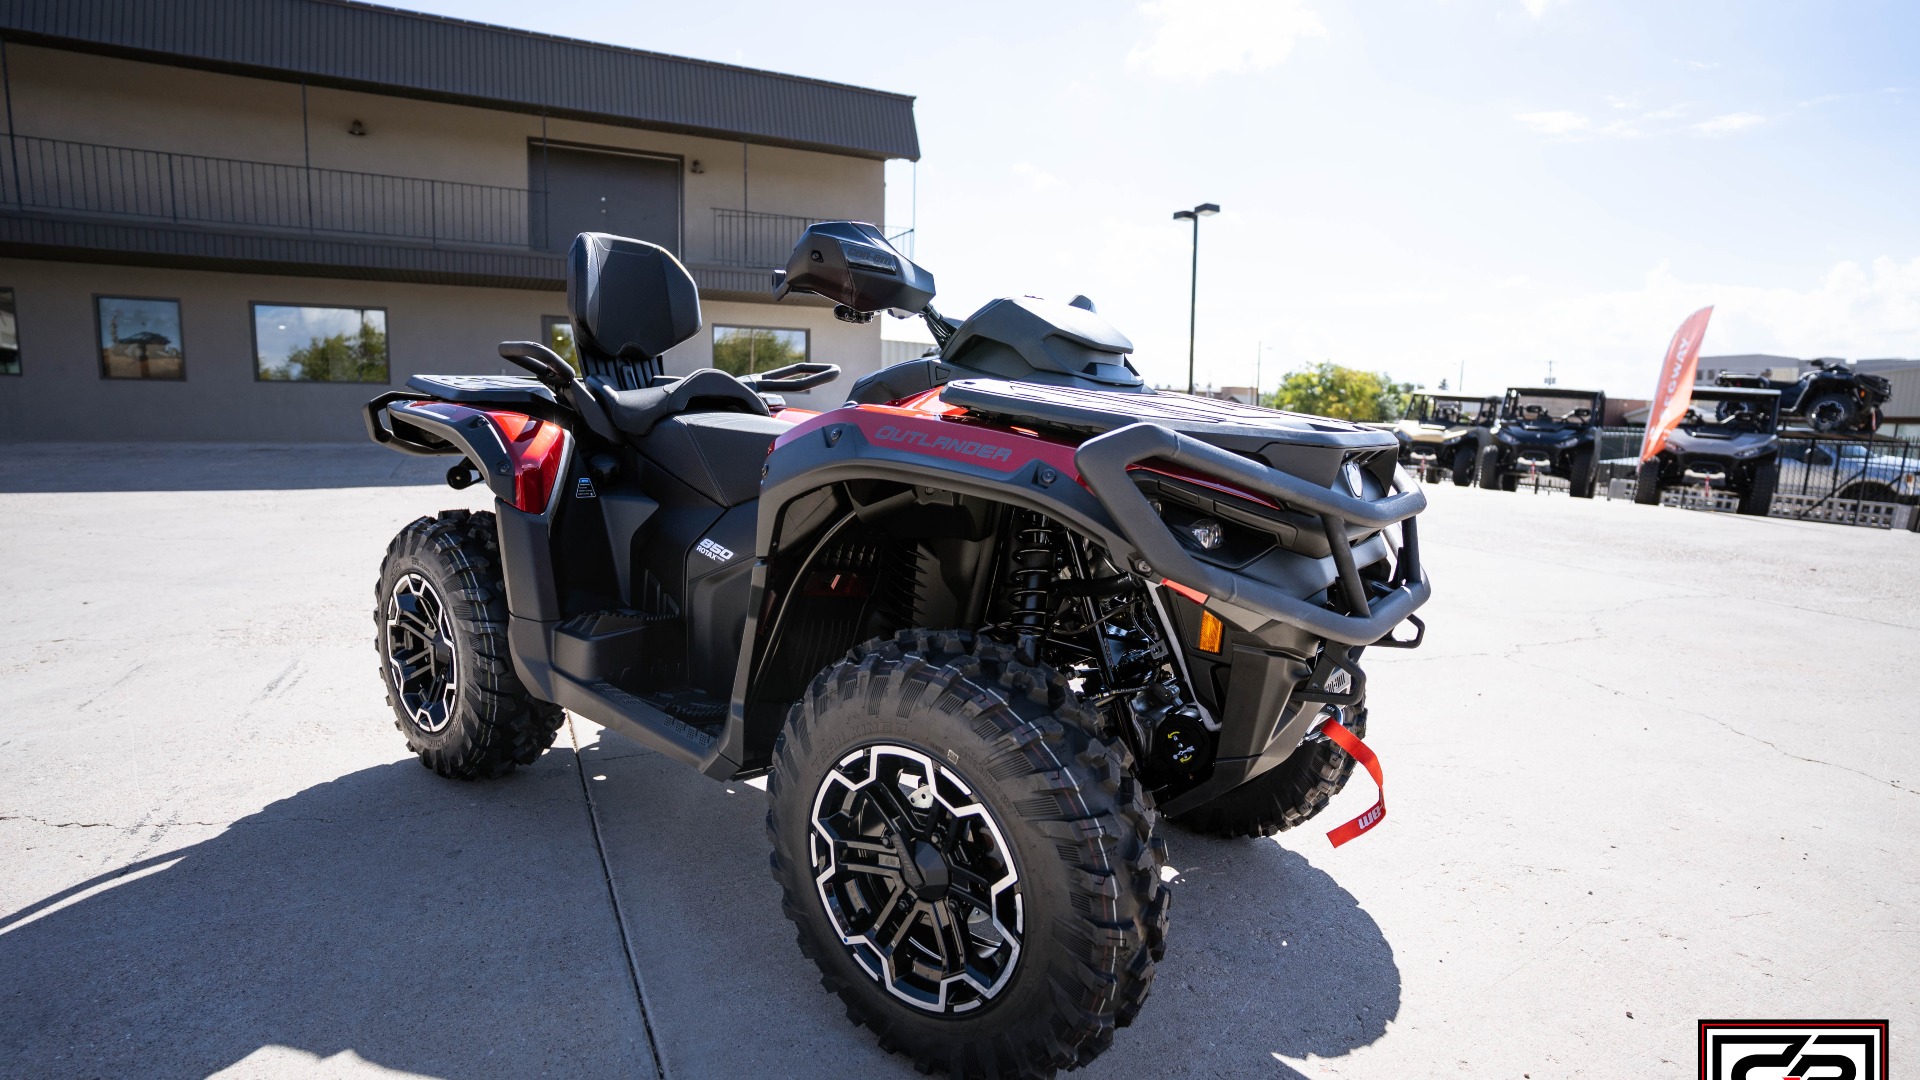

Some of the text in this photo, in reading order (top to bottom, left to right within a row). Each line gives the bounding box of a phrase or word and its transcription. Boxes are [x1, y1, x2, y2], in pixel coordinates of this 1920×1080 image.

[874, 425, 1012, 462] OUTLANDER
[696, 545, 717, 561] ROTAX
[699, 538, 734, 560] 850
